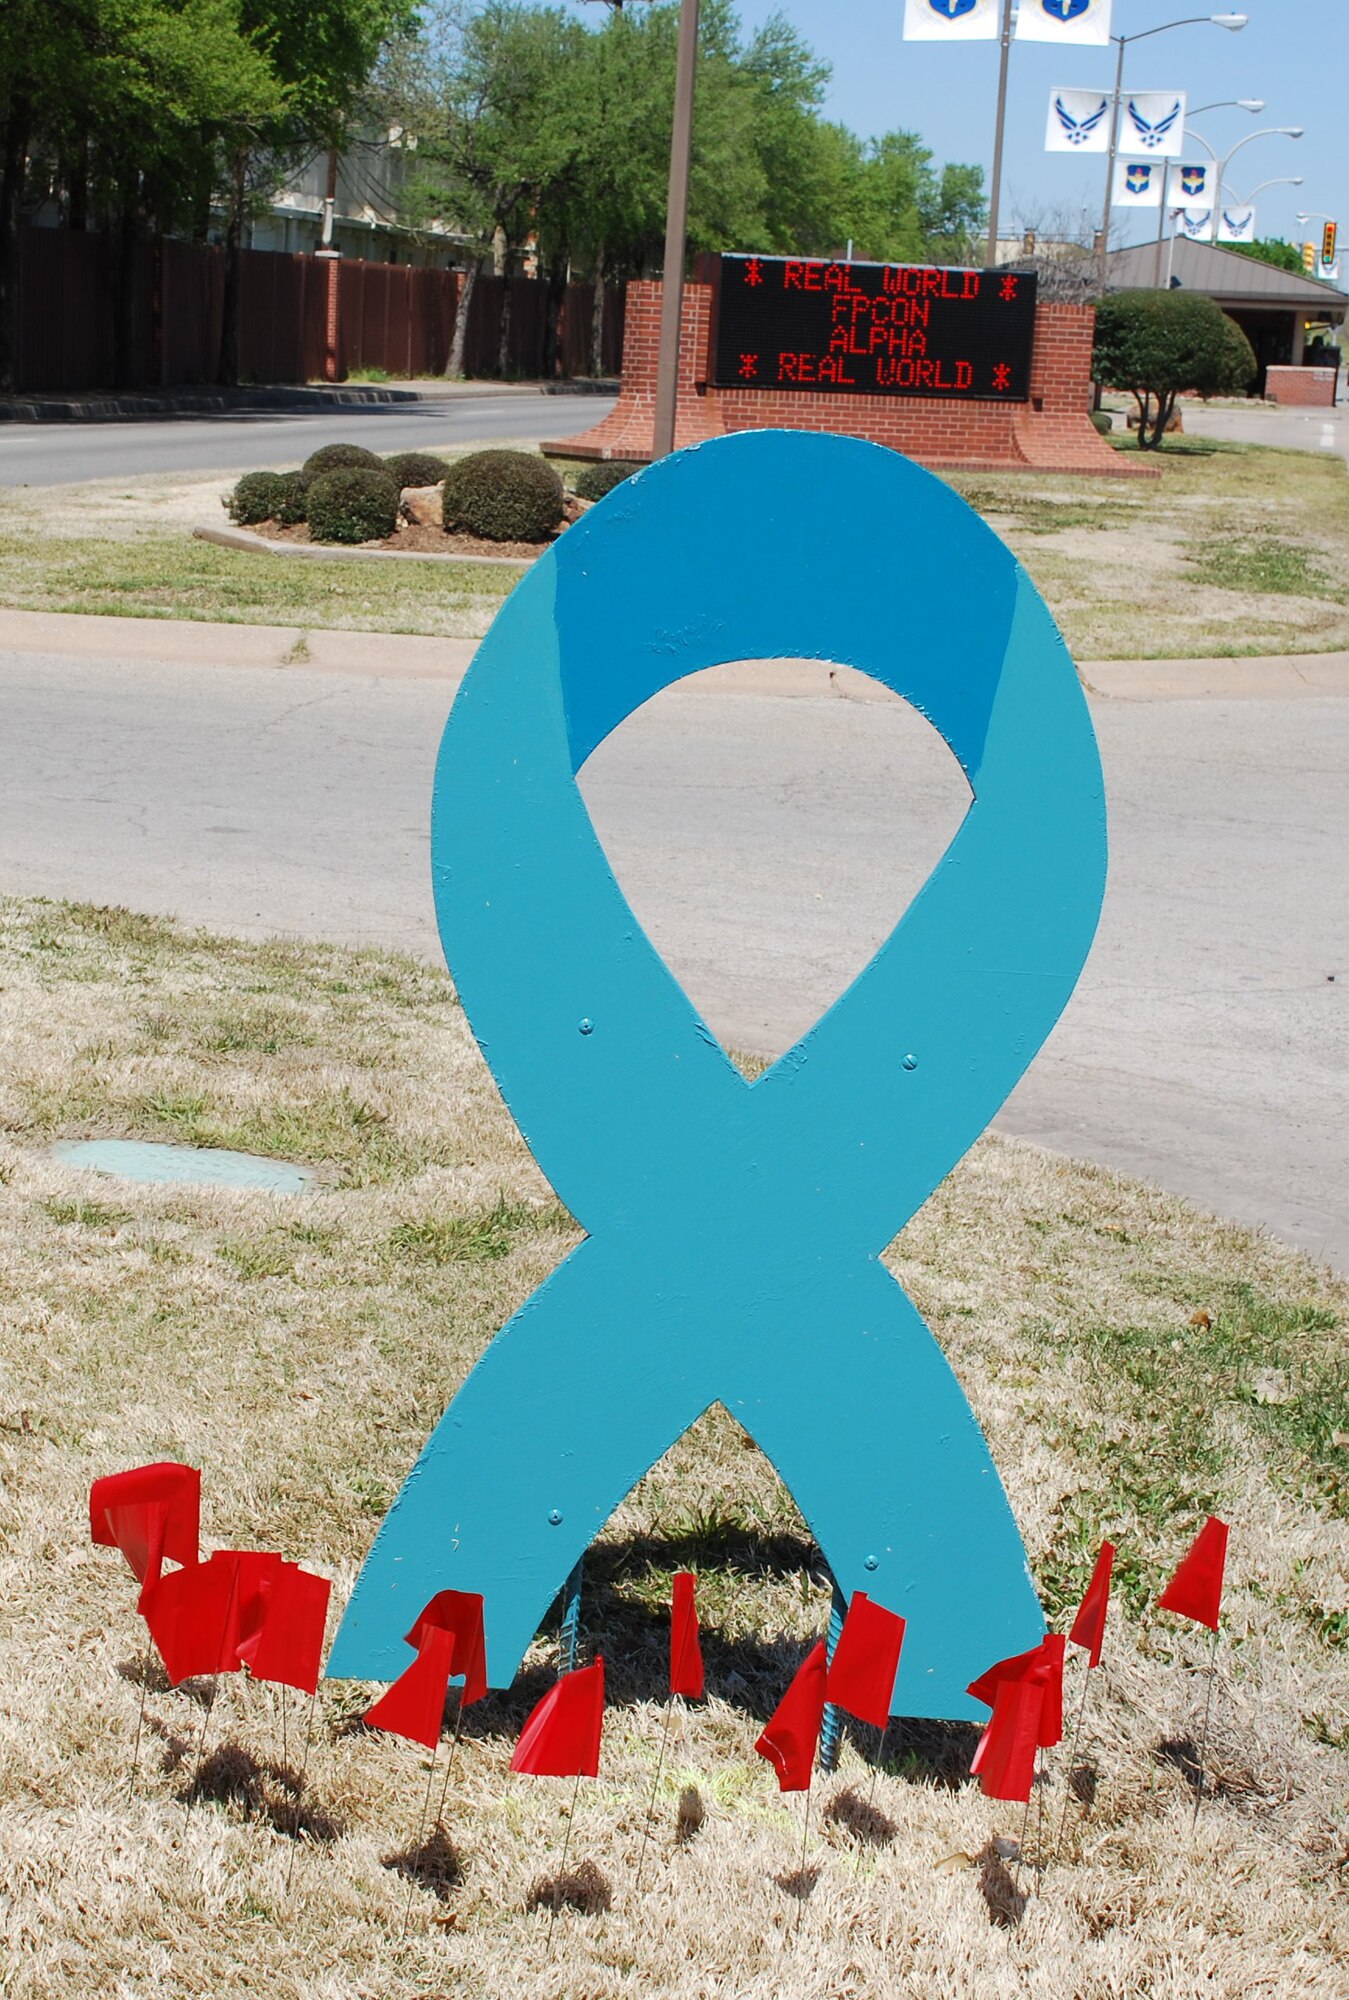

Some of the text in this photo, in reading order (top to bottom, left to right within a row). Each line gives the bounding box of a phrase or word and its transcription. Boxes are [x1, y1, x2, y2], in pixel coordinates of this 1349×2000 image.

[784, 260, 979, 298] REAL WORLD
[832, 295, 929, 326] FPCON
[830, 325, 926, 355] ALPHA
[778, 353, 972, 388] REAL WORLD
